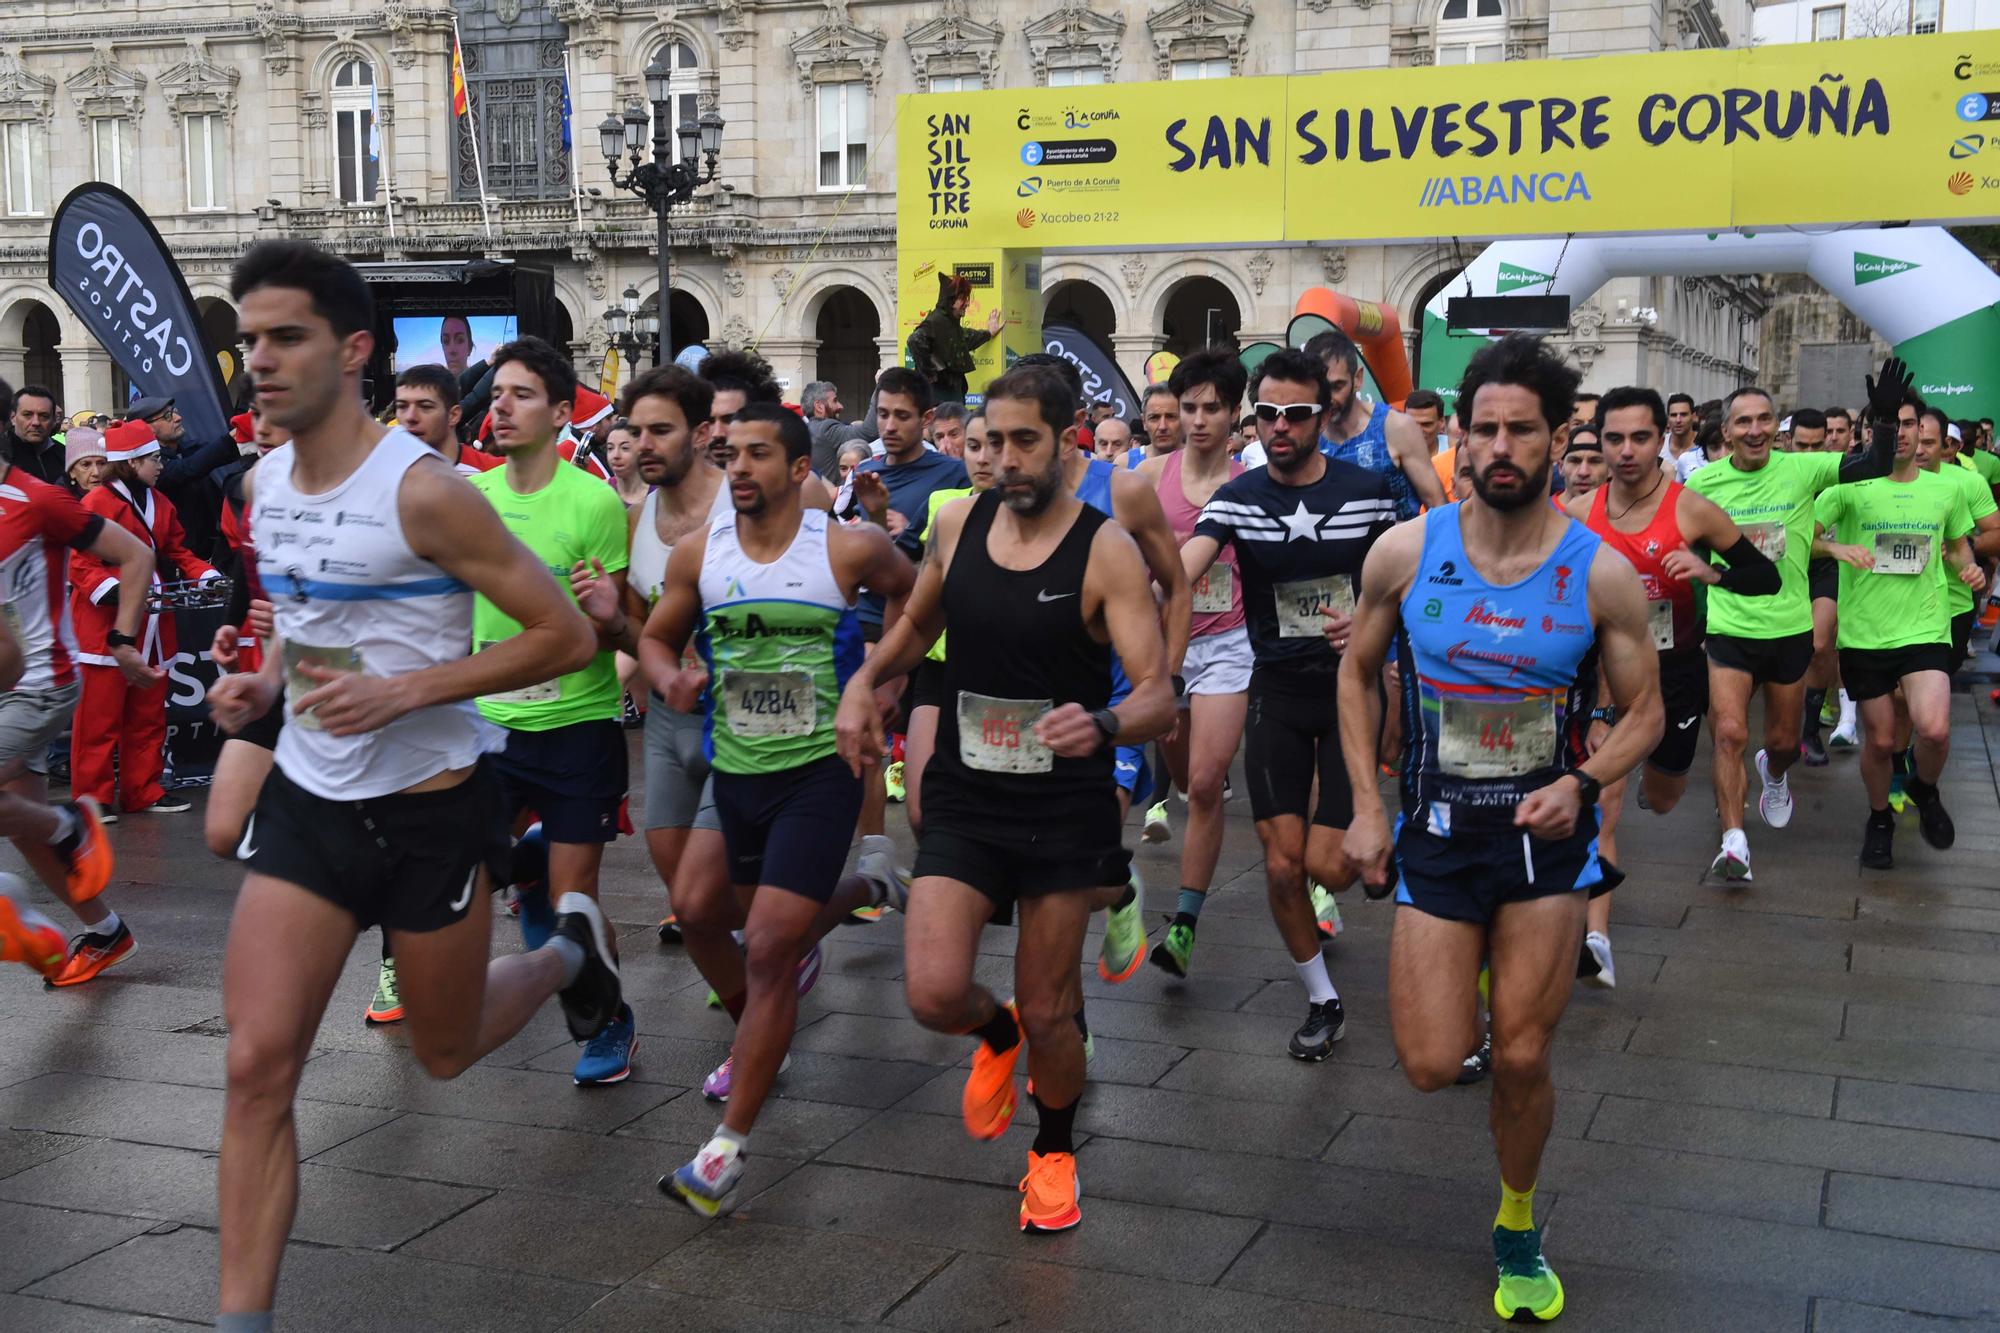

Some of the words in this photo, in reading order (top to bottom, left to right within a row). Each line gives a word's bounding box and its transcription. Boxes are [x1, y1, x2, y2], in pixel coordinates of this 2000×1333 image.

[927, 113, 970, 137] SAN
[1165, 115, 1271, 172] SAN
[1296, 96, 1611, 165] SILVESTRE
[1638, 73, 1890, 146] CORUÑA
[927, 138, 971, 165] SIL
[927, 166, 971, 190] VES
[1047, 179, 1072, 187] Puerto
[1093, 177, 1120, 185] Coruña
[928, 191, 970, 216] TRE
[929, 217, 969, 230] CORUÑA
[1040, 212, 1091, 223] Xacobeo
[1893, 544, 1917, 559] 601
[742, 689, 797, 714] 4284
[983, 719, 1020, 748] 105
[1480, 722, 1514, 752] 44
